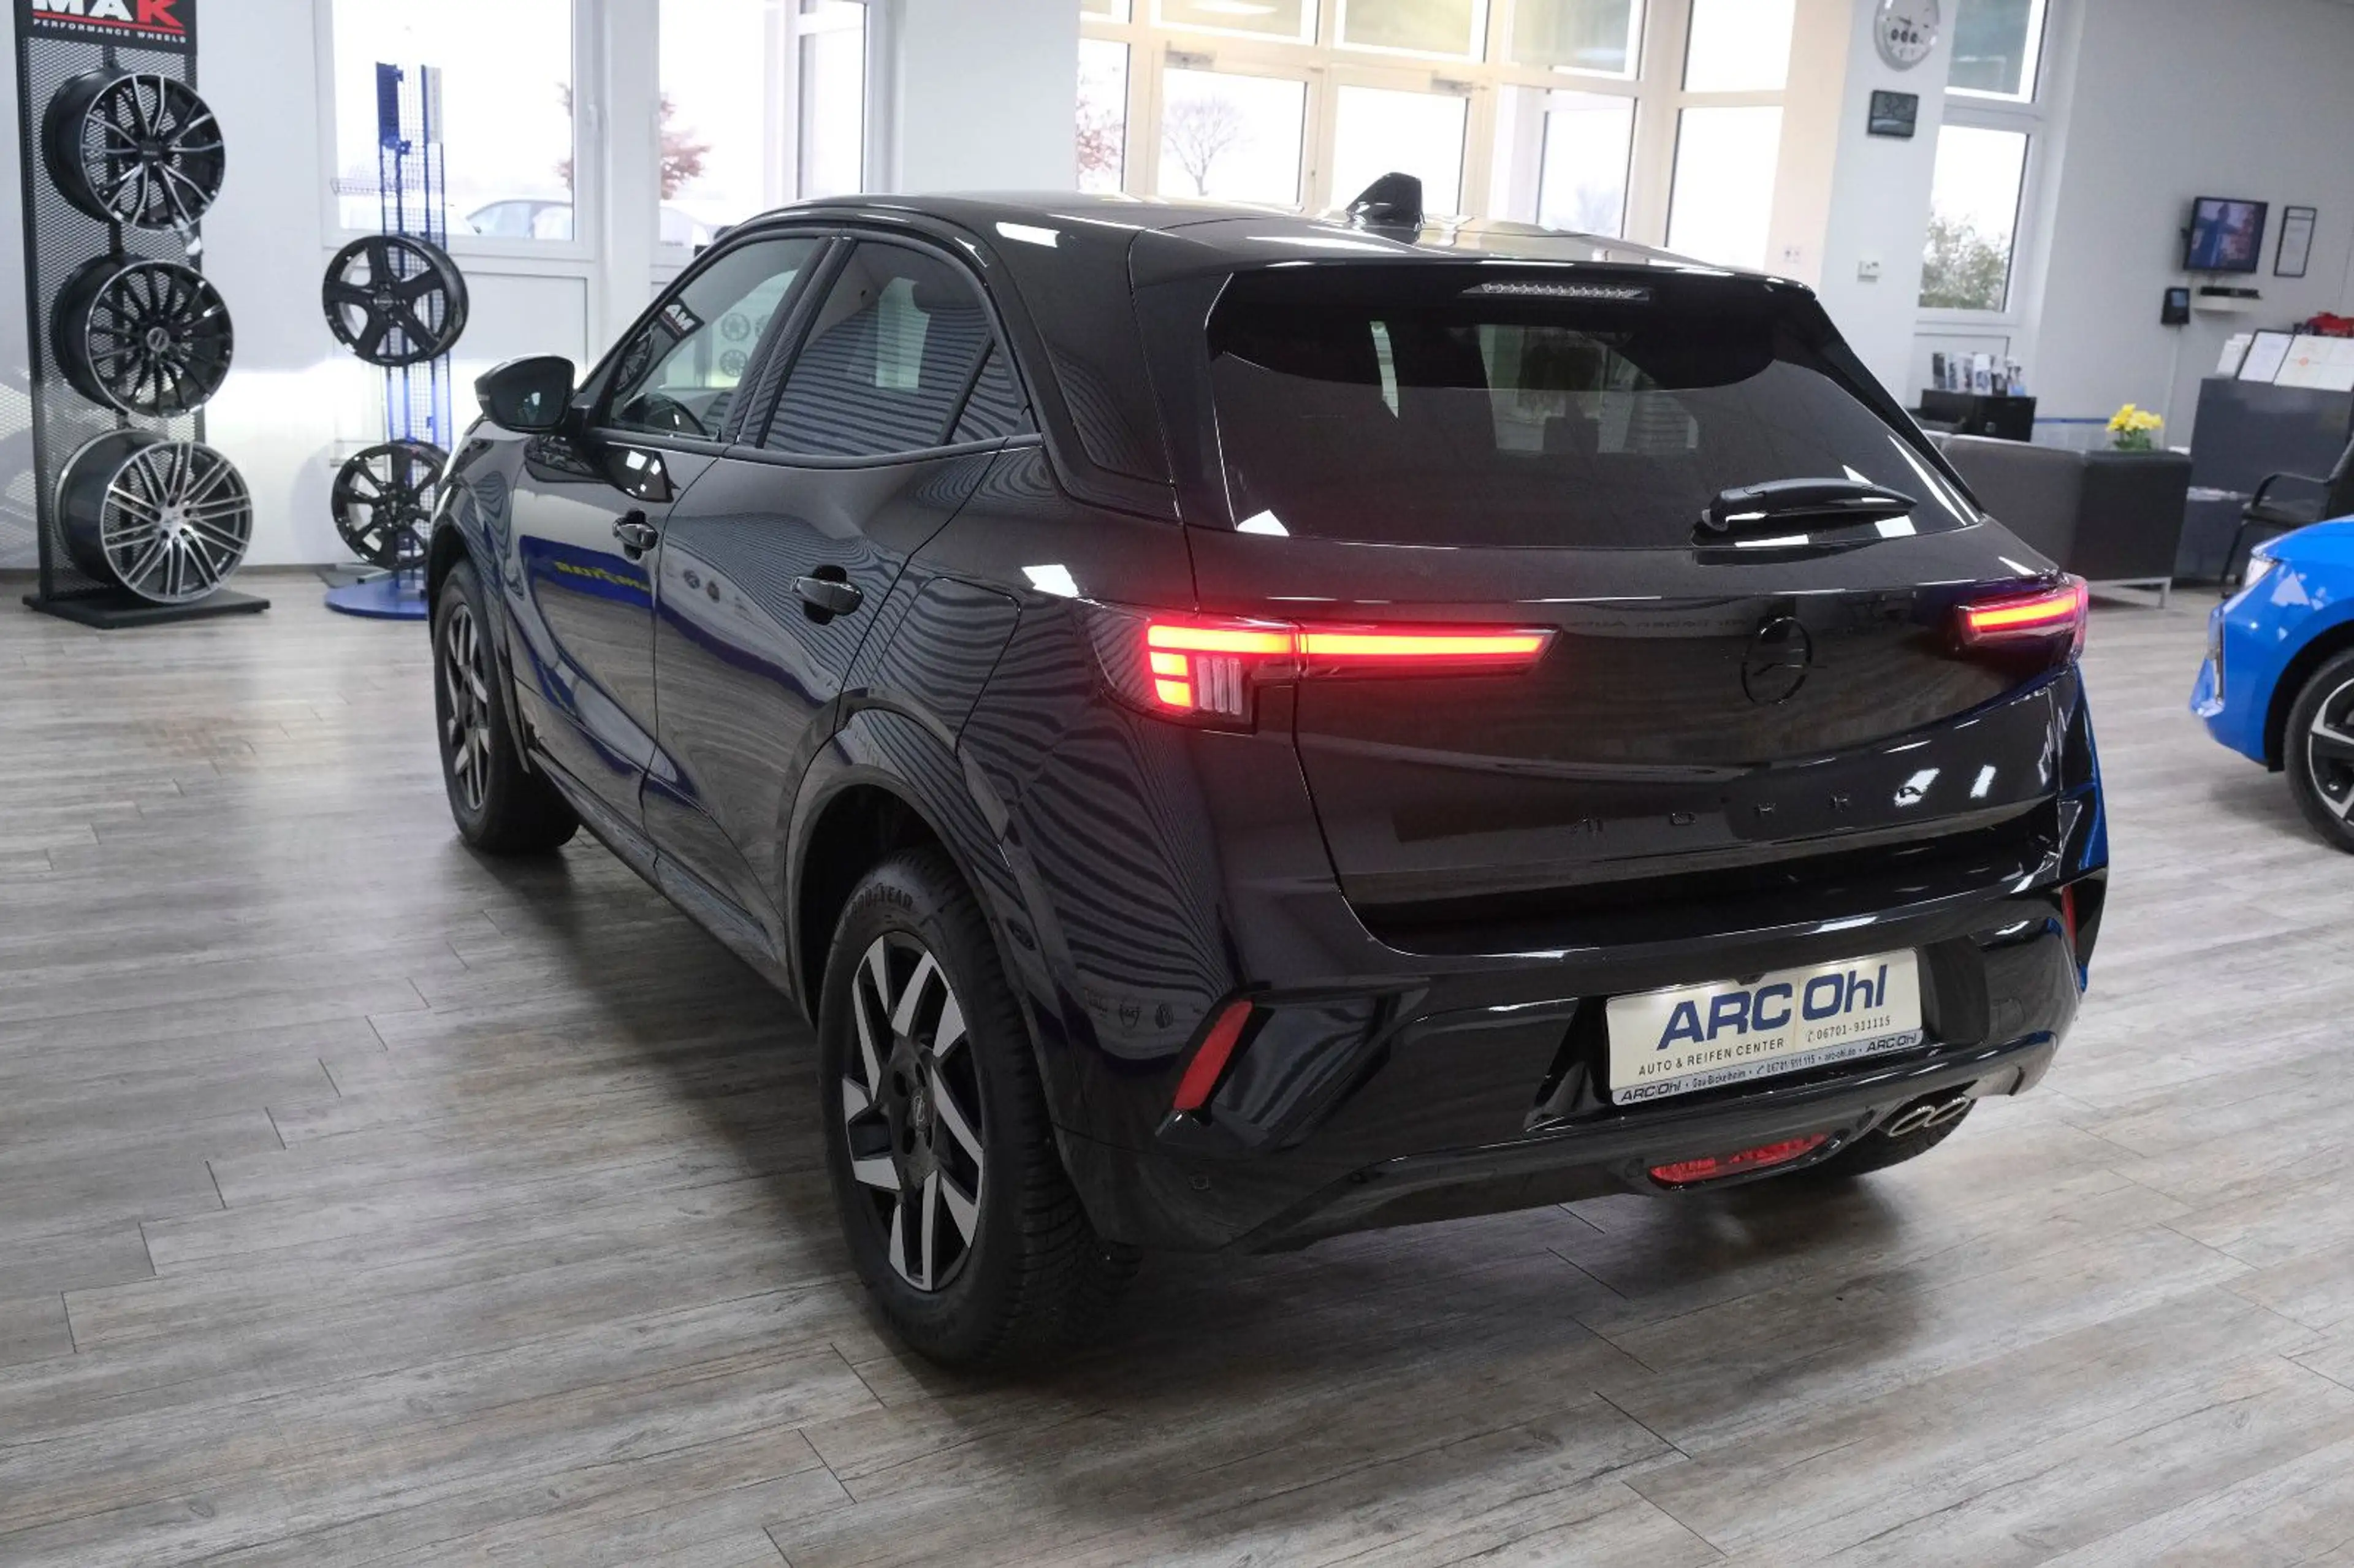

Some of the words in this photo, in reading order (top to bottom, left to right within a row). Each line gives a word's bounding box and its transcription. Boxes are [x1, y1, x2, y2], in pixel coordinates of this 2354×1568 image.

[32, 18, 131, 37] PERFORMANCE
[137, 31, 186, 43] WHEELS
[1656, 983, 1792, 1051] ARC
[1802, 964, 1888, 1021] Ohl
[1639, 1060, 1672, 1076] AUTO
[1677, 1057, 1683, 1069] &
[1687, 1049, 1732, 1066] REIFEN
[1736, 1038, 1785, 1056] CENTER
